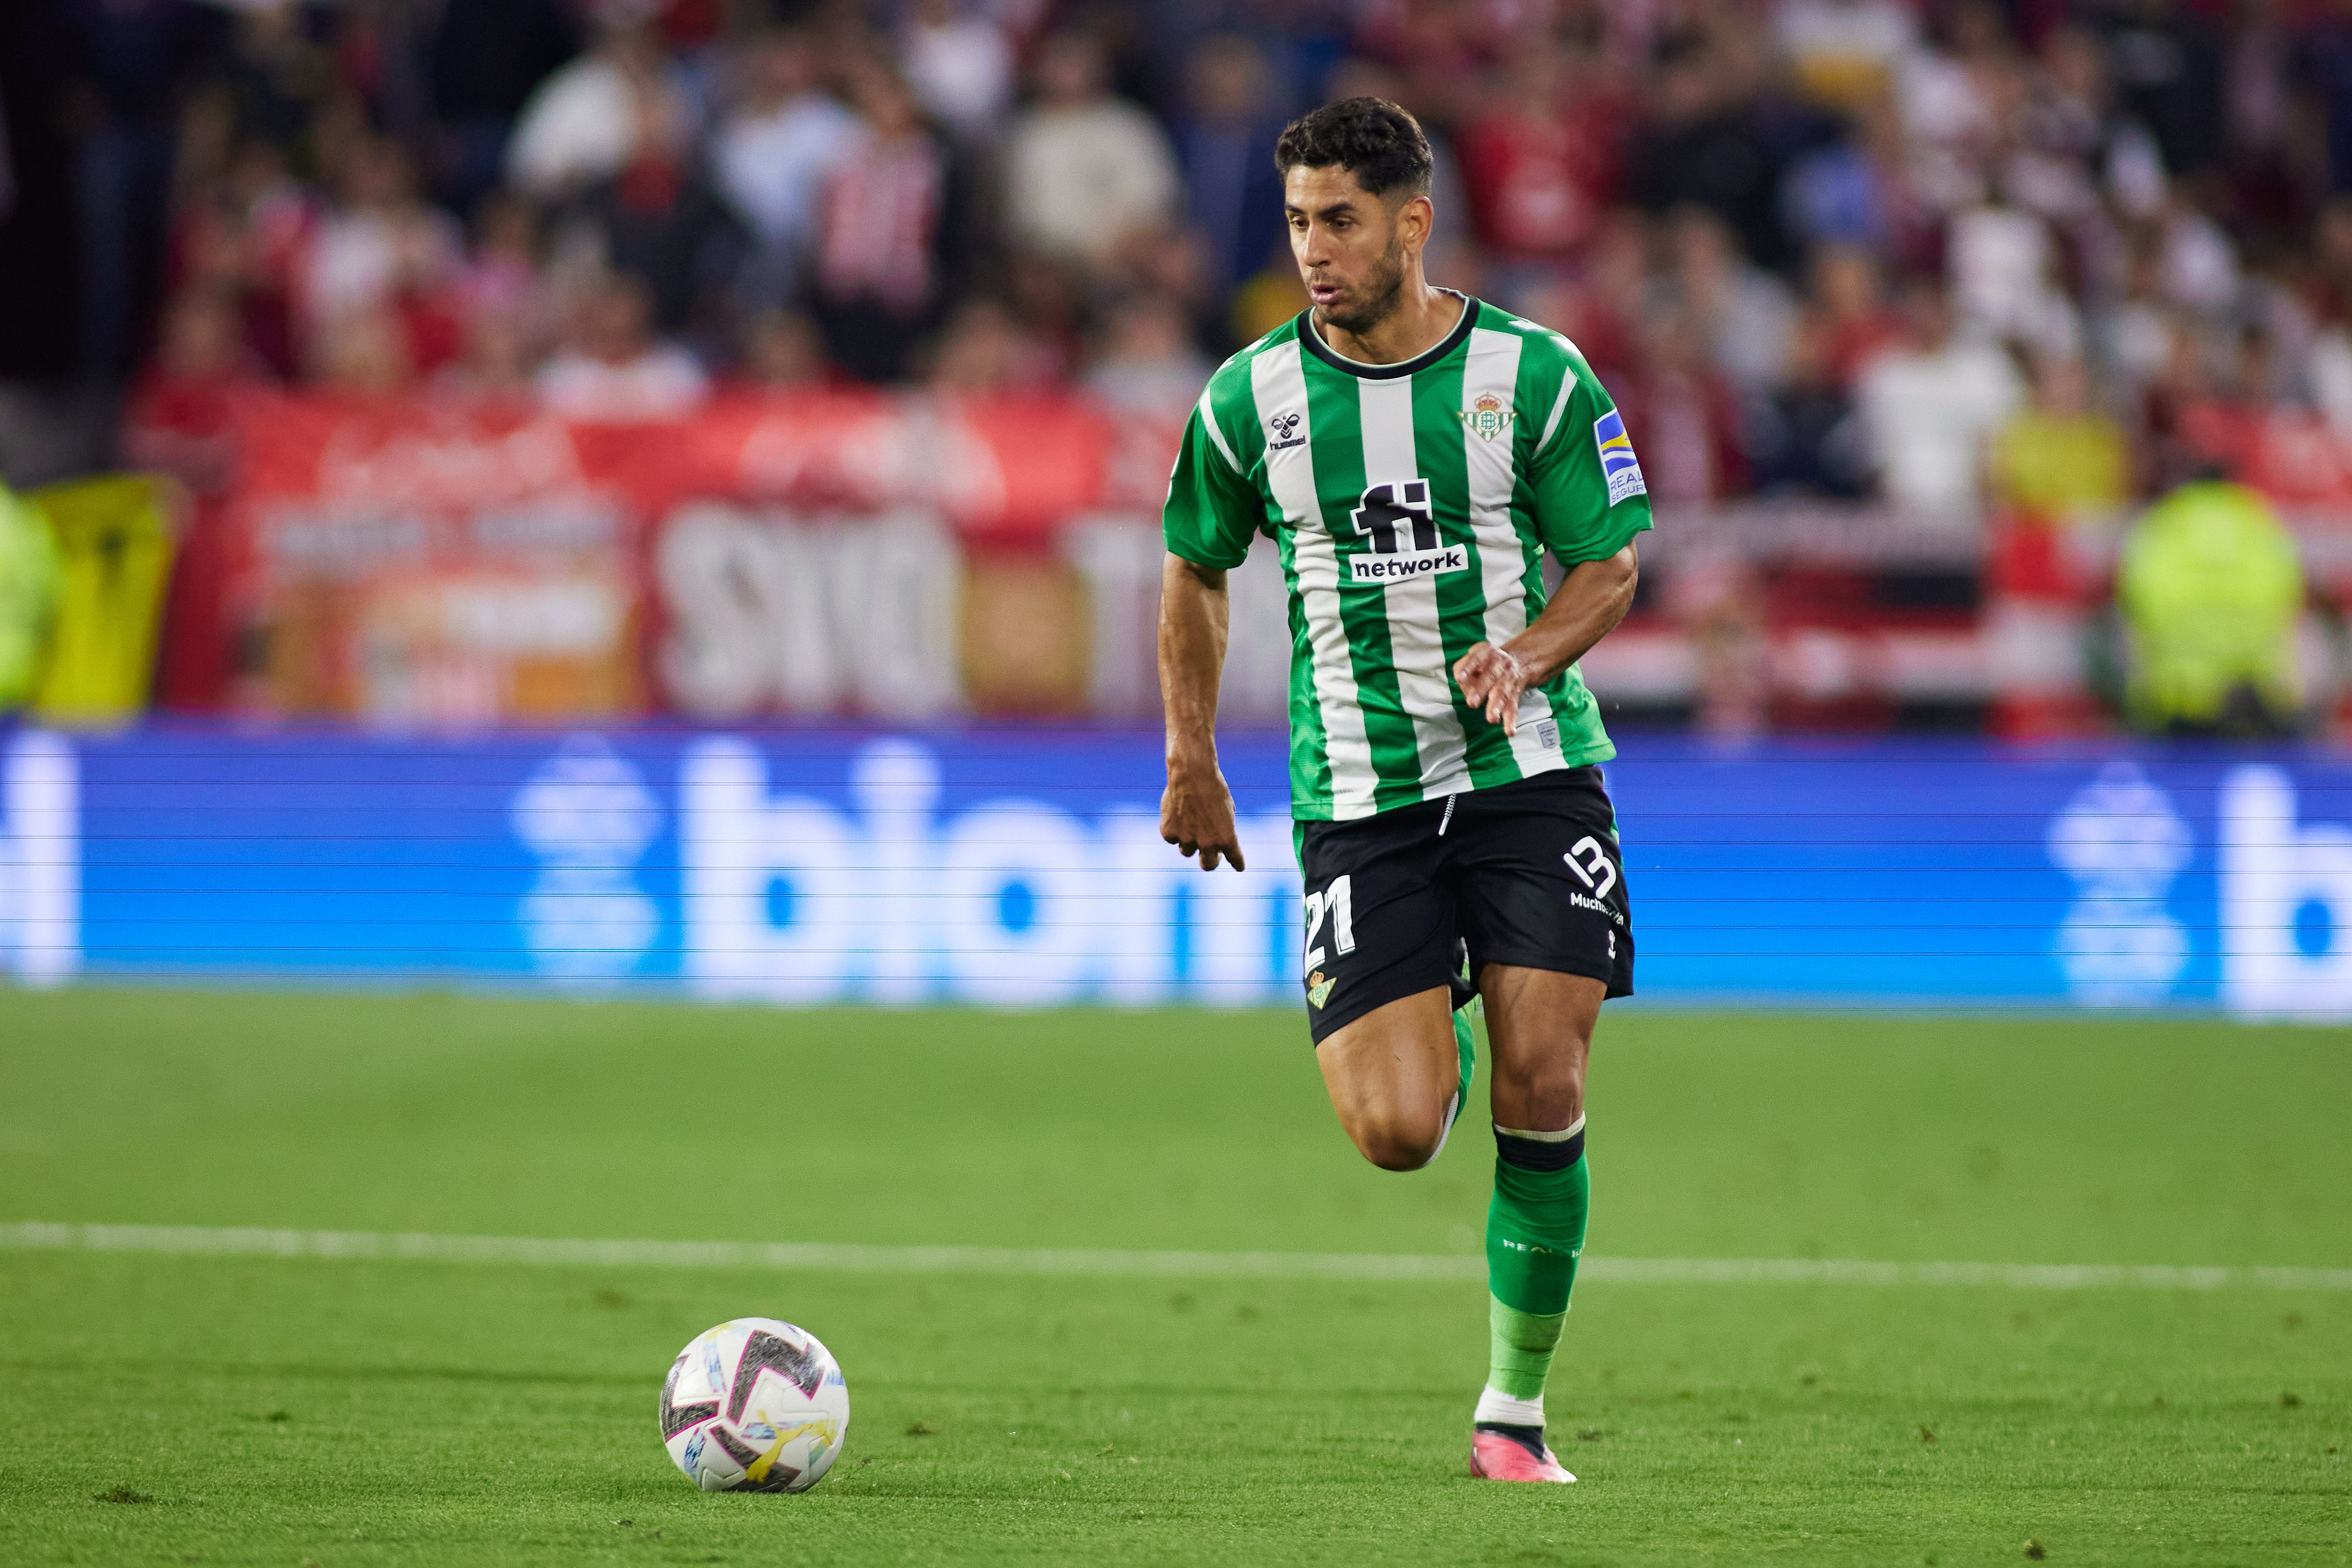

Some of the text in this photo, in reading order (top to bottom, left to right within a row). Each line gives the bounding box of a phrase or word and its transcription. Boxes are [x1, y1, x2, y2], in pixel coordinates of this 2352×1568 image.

[1270, 435, 1306, 451] hummel
[1355, 551, 1462, 577] network
[1304, 875, 1356, 978] 21
